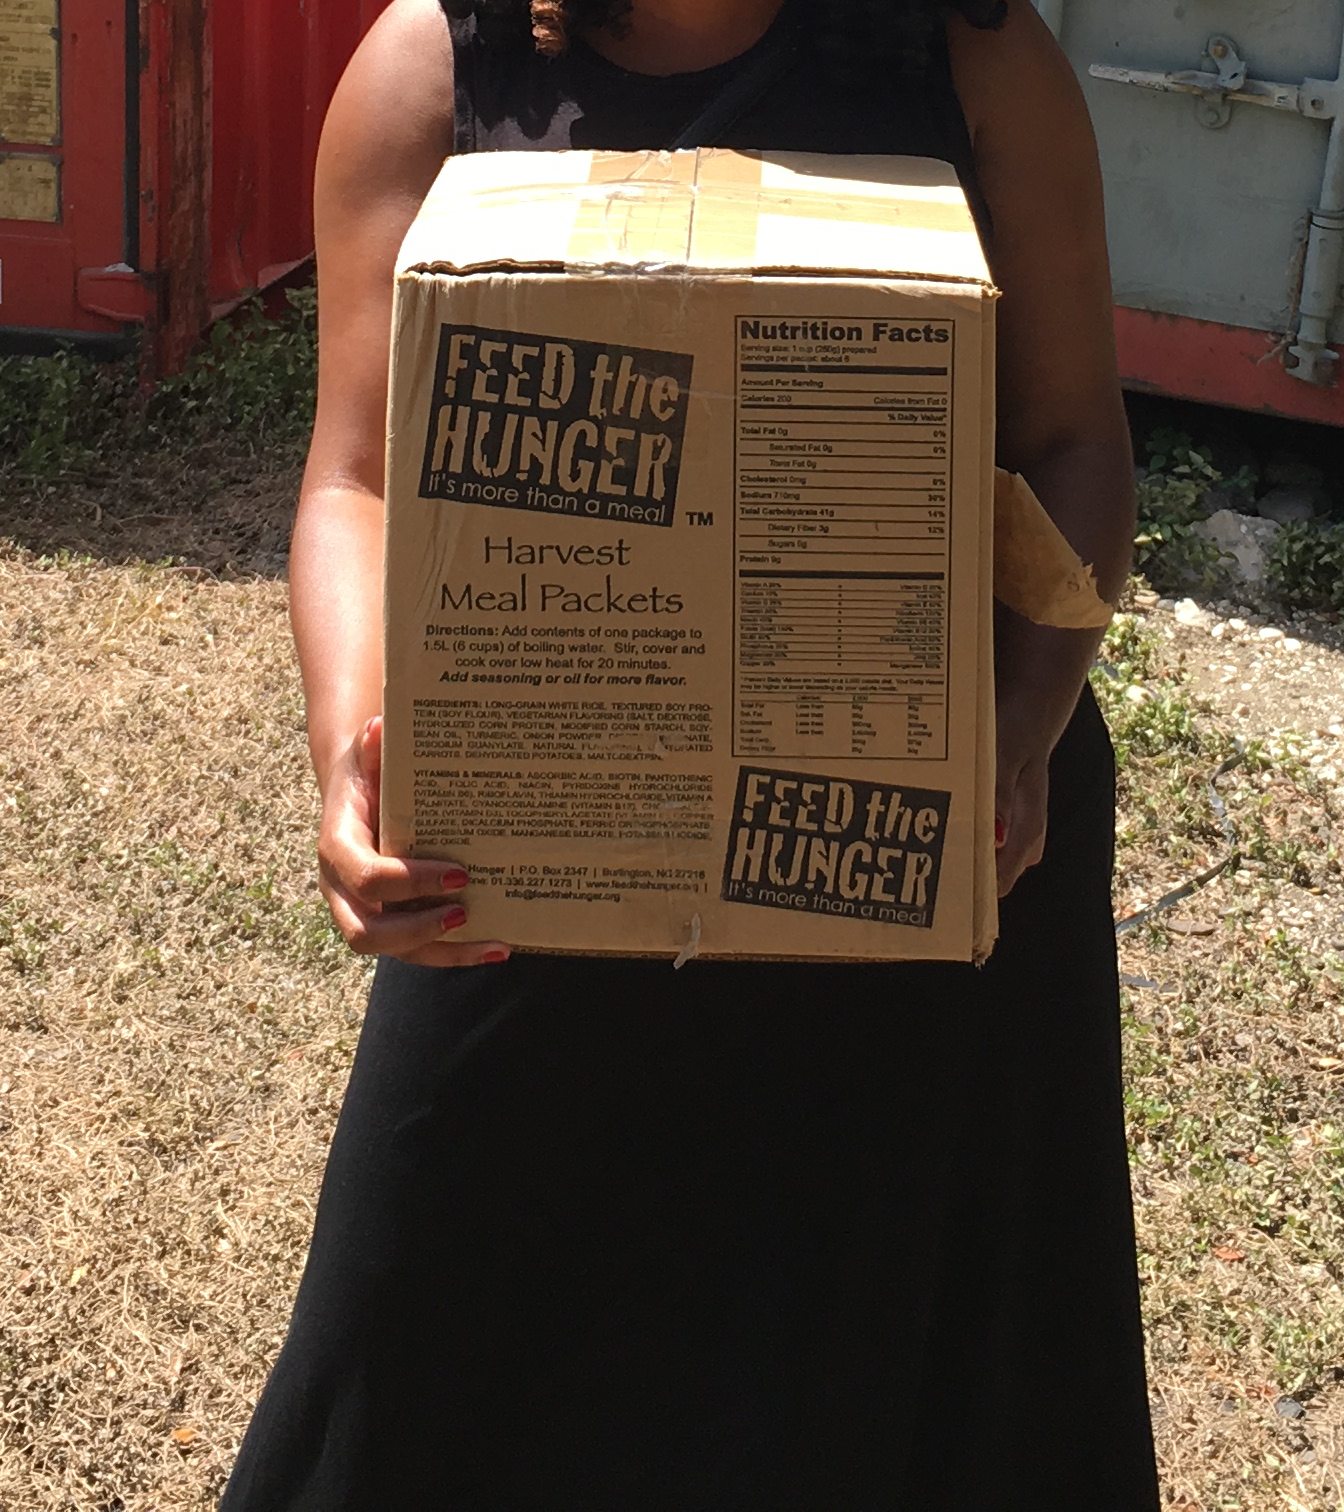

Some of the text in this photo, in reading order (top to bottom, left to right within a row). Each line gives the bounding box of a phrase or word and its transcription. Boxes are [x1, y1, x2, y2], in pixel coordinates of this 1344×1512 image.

[741, 321, 950, 343] Nutrition Facts
[445, 334, 680, 422] FEED the
[431, 405, 673, 501] HUNGER
[429, 474, 665, 524] It's more than a meal
[685, 511, 714, 526] TM
[484, 536, 632, 566] Harvest
[440, 573, 684, 614] Meal Packets
[425, 624, 703, 641] Directions: Add contents of one package to
[453, 640, 466, 653] (6
[469, 640, 504, 655] cups)
[507, 641, 520, 652] of
[523, 641, 565, 655] boiling
[614, 642, 639, 656] Stir,
[642, 644, 678, 654] cover
[681, 643, 706, 655] and
[455, 656, 671, 670] cook over low heat for 20 minutes.
[439, 671, 687, 686] Add seasoning or oil for more flavor.
[742, 774, 940, 844] FEED the
[468, 864, 506, 876] Hunger
[542, 865, 562, 876] Box
[563, 866, 588, 876] 2347
[731, 827, 933, 908] HUNGER
[728, 881, 928, 925] It's more than a meal
